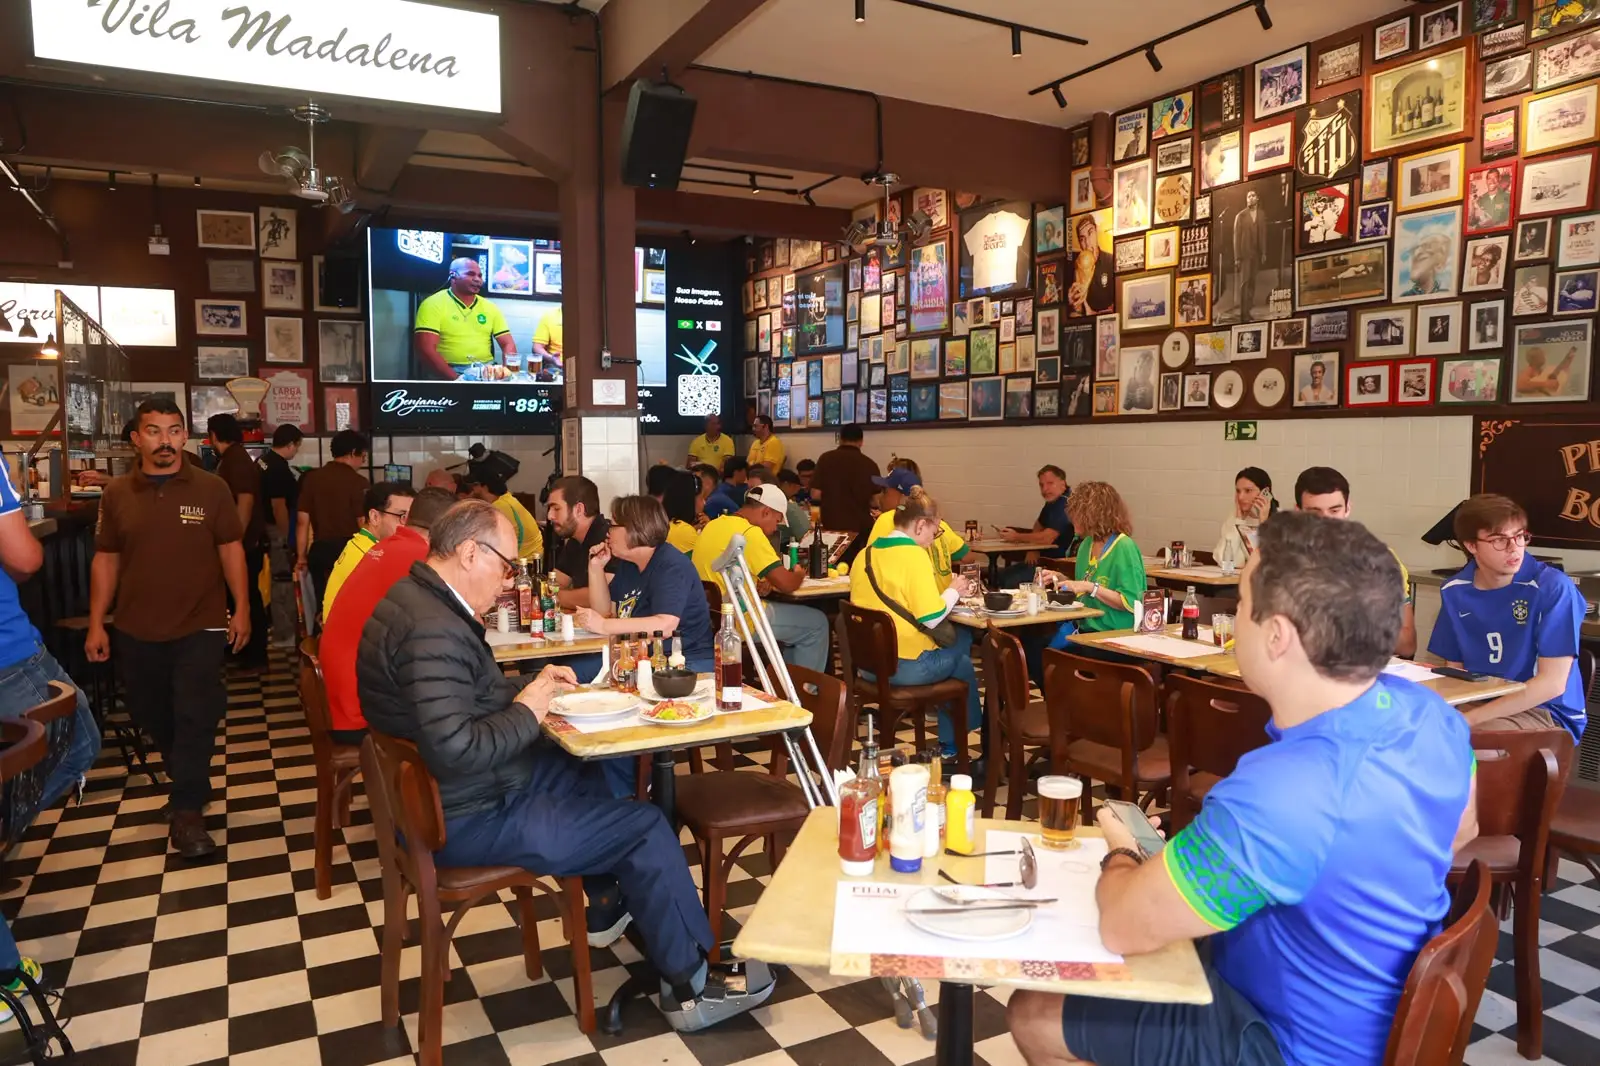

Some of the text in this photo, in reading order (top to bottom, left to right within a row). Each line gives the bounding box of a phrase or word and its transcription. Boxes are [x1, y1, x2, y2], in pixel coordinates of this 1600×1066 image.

[88, 0, 462, 78] Vila Madalena
[675, 286, 721, 297] Sua Imagem.
[1269, 288, 1291, 300] James
[674, 296, 723, 306] Nosso Padrão
[272, 387, 302, 396] LARGA
[274, 401, 302, 411] TOMA
[380, 389, 459, 416] Benjamin
[515, 399, 538, 412] 89
[1486, 632, 1503, 664] 9
